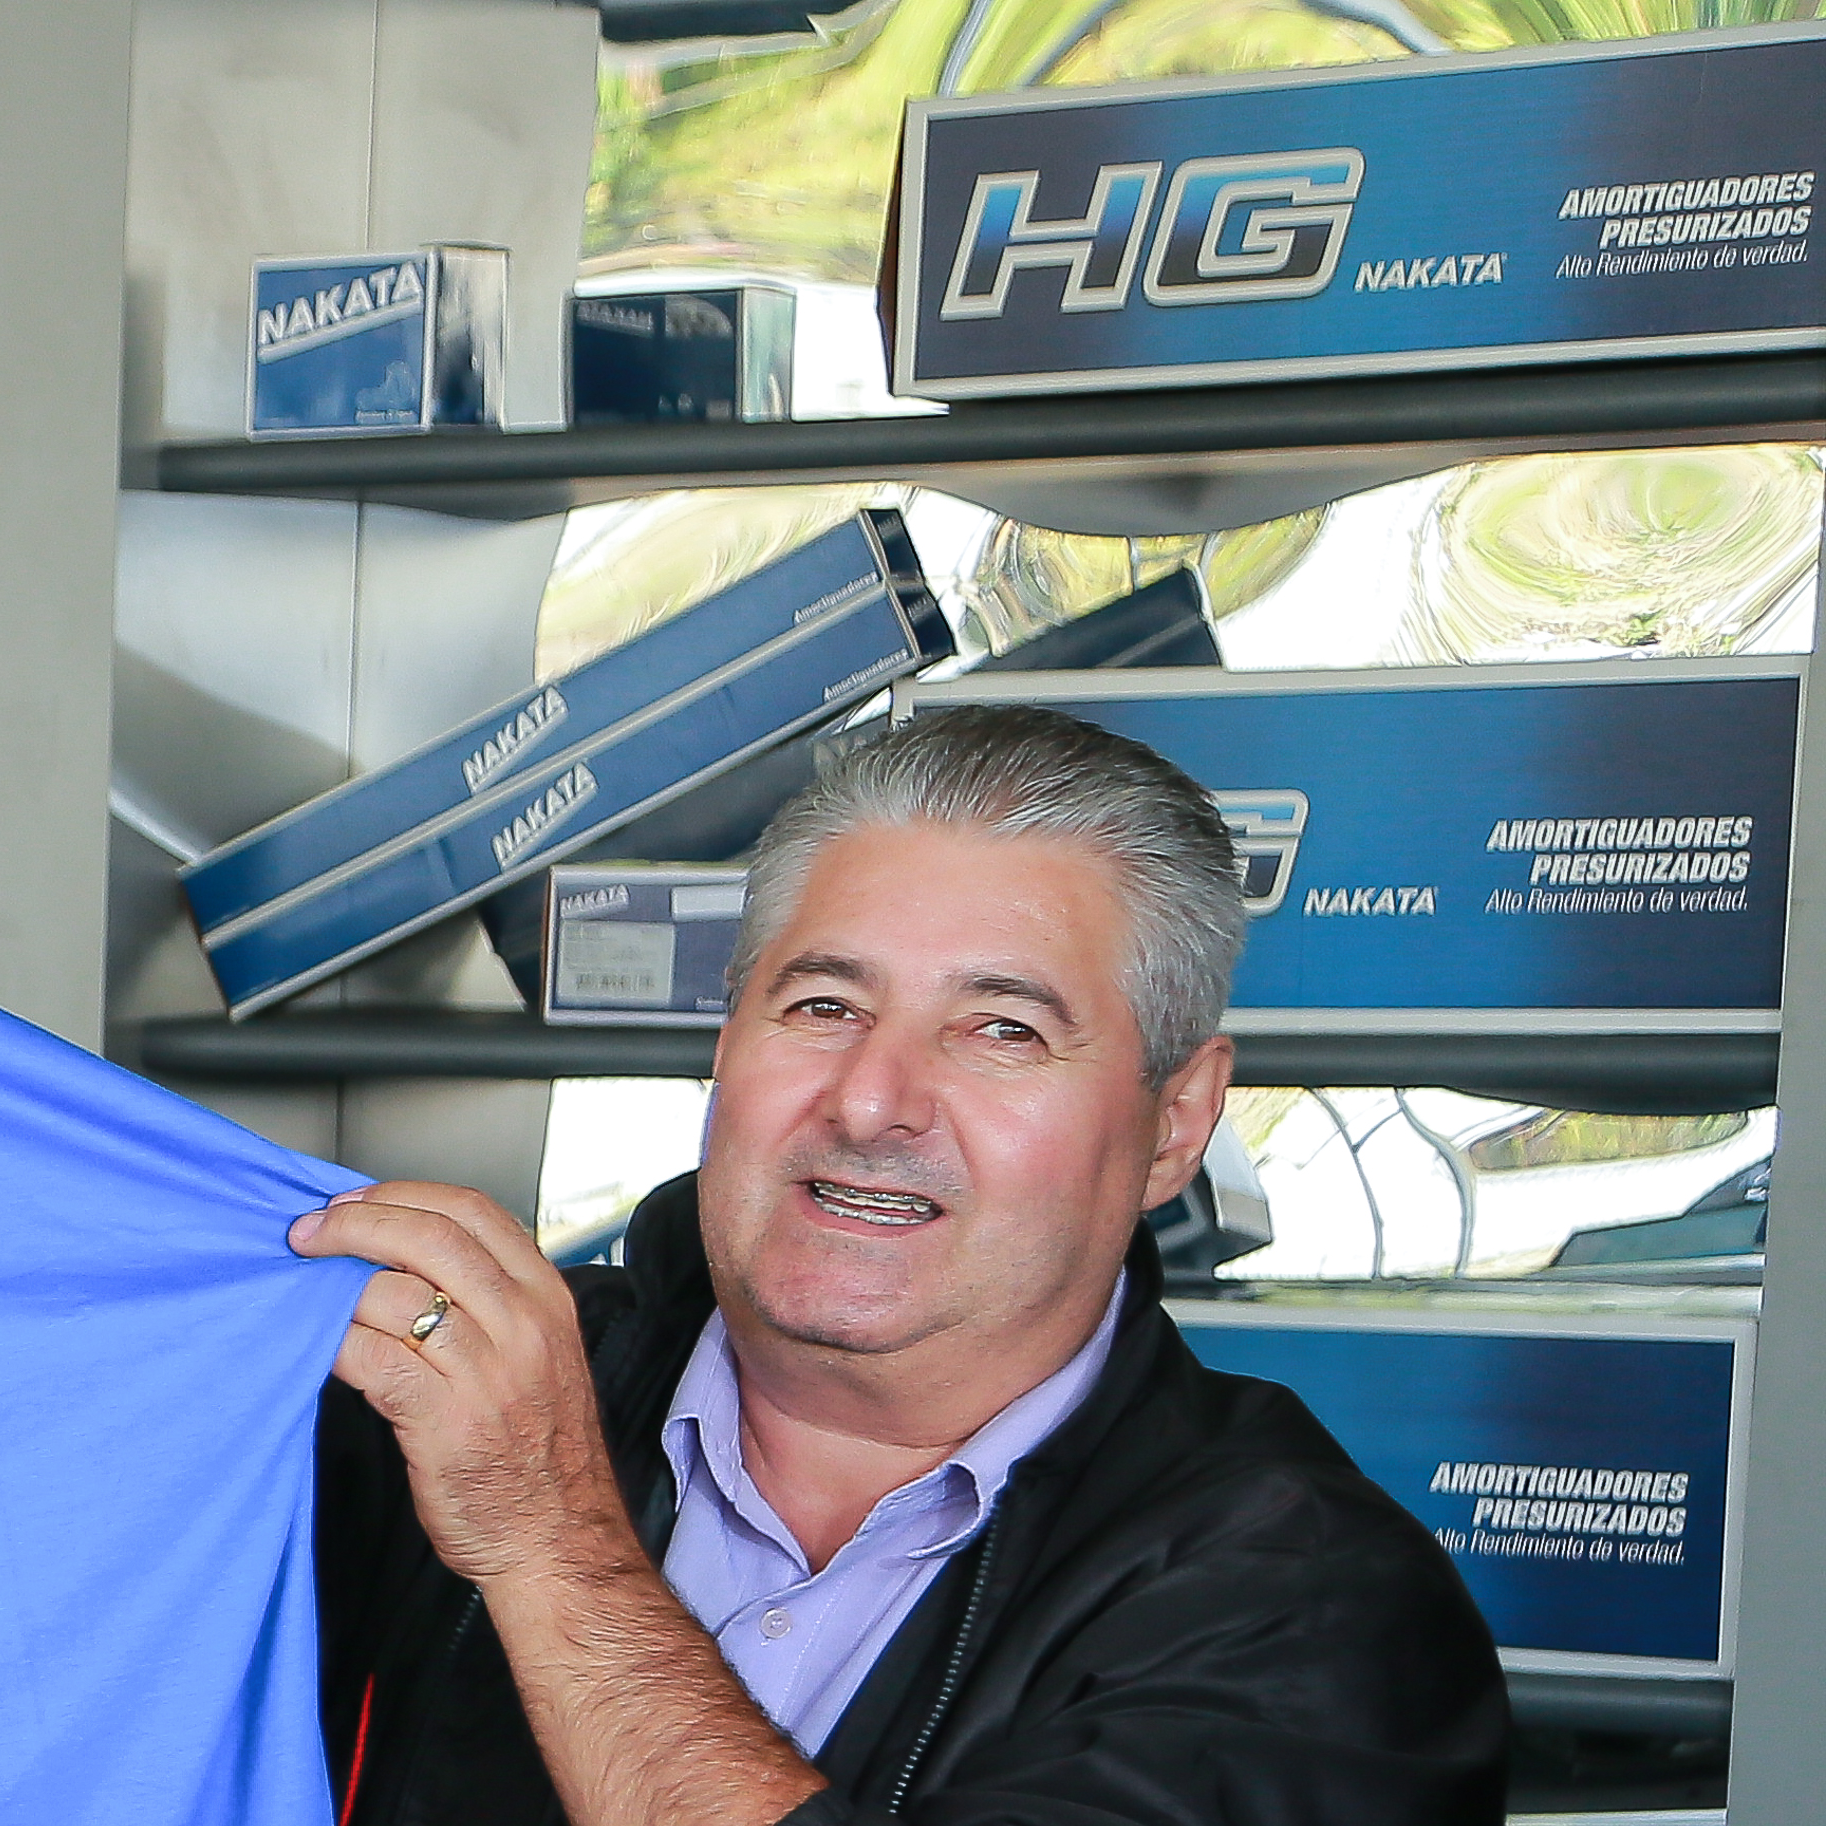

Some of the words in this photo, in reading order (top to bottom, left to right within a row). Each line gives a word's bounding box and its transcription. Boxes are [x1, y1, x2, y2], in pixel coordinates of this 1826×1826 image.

[1558, 171, 1816, 220] AMORTIGUADORES
[939, 147, 1367, 322] HG
[1599, 205, 1813, 250] PRESURIZADOS
[1595, 245, 1709, 278] Rendimiento
[1712, 244, 1738, 269] de
[1742, 238, 1810, 267] verdad.
[258, 260, 425, 346] NAKATA
[462, 684, 568, 795] NAKATA
[492, 761, 598, 872] NAKATA
[1486, 815, 1753, 852] AMORTIGUADORES
[1528, 850, 1751, 886] PRESURIZADOS
[560, 883, 630, 914] NAKATA
[1527, 886, 1646, 915] Rendimiento
[1649, 887, 1675, 913] de
[1680, 884, 1749, 912] verdad.
[1428, 1460, 1690, 1504] AMORTIGUADORES
[1471, 1496, 1688, 1538] PRESURIZADOS
[1470, 1528, 1585, 1562] Rendimiento
[1588, 1535, 1614, 1563] de
[1618, 1539, 1686, 1566] verdad.
